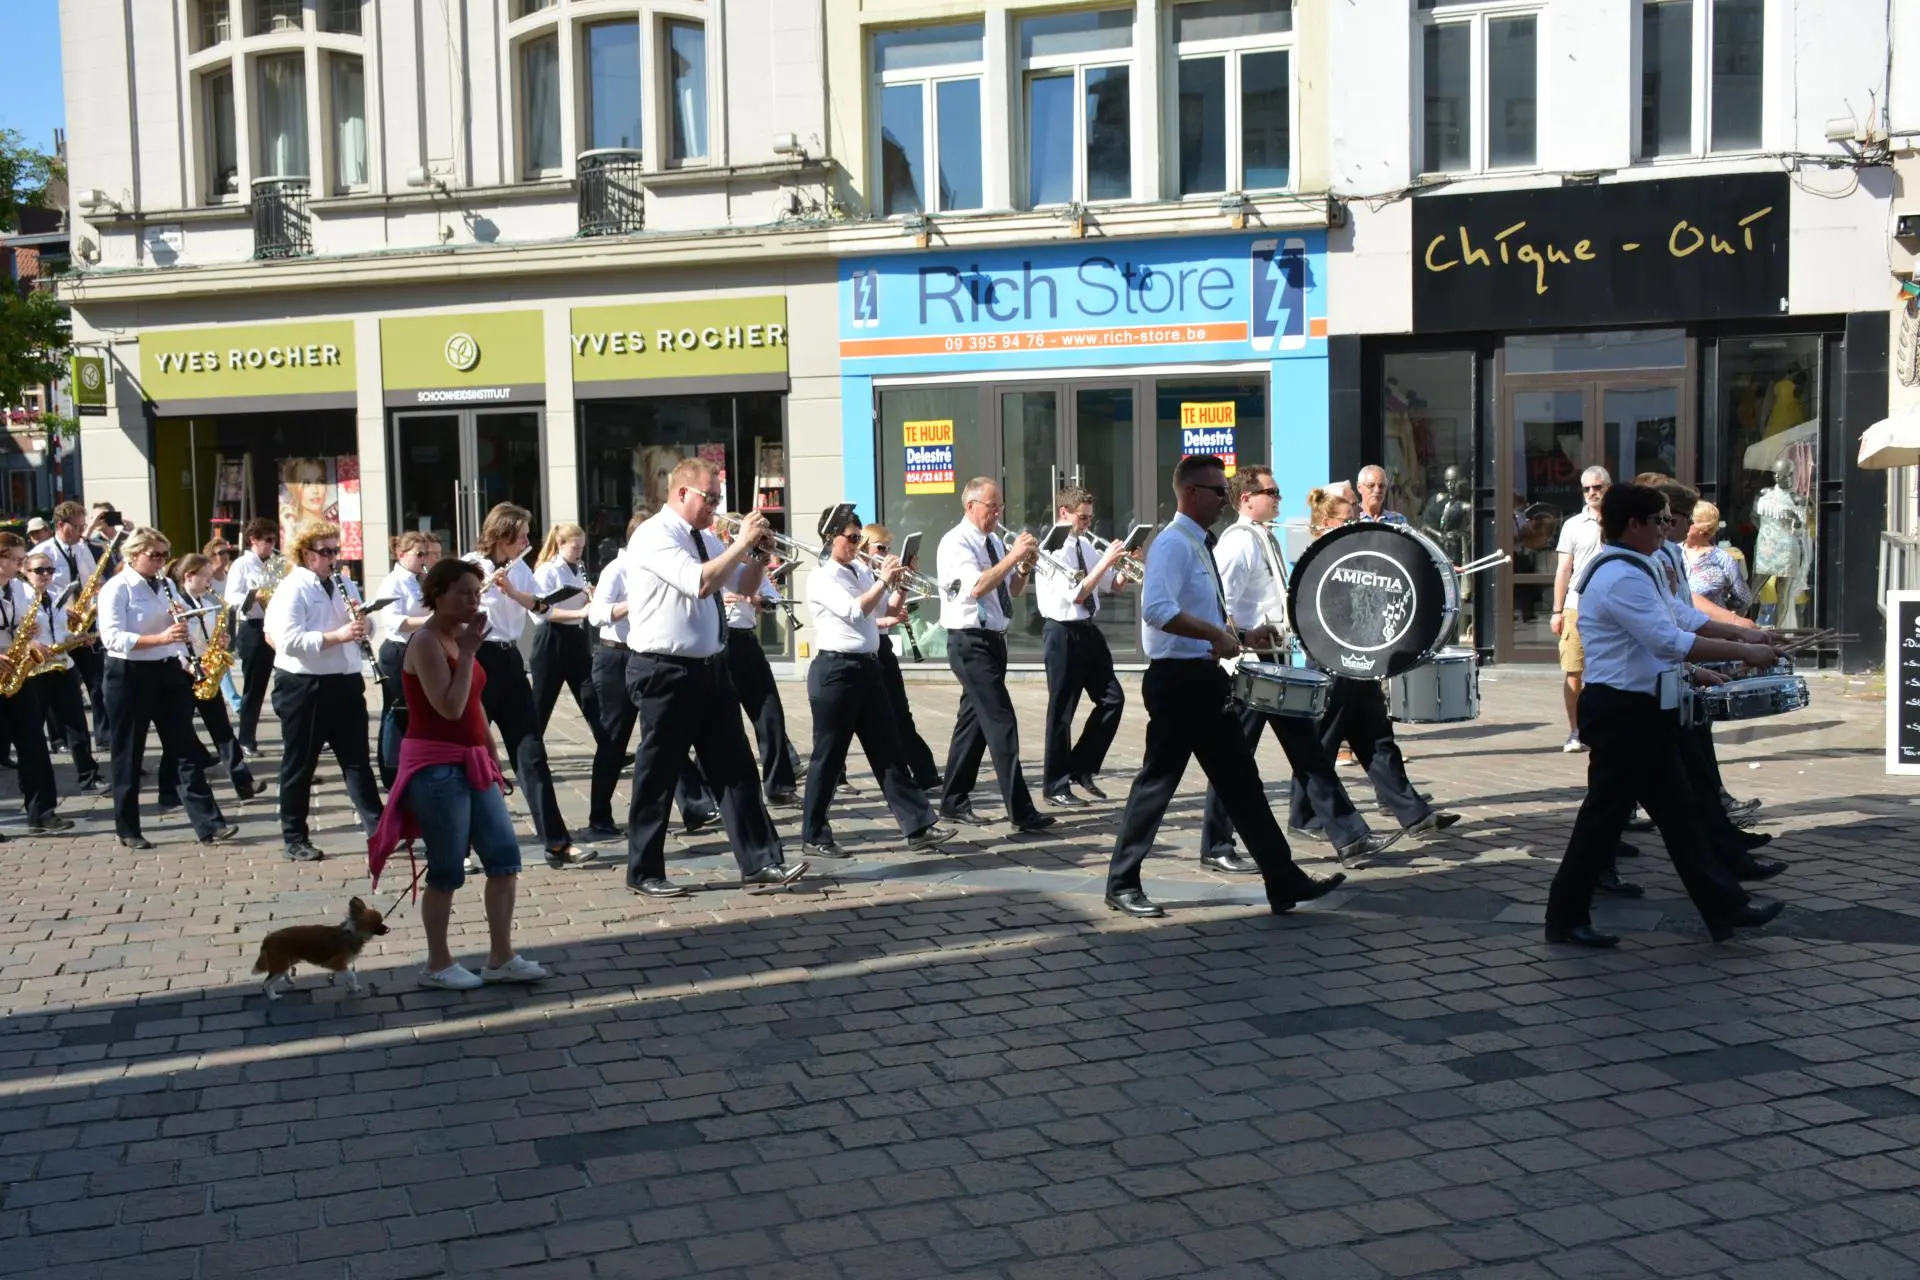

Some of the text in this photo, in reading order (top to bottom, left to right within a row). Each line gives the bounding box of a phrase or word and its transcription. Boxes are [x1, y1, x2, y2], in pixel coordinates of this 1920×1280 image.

[1424, 220, 1596, 295] Chique
[918, 256, 1234, 324] Rich Store
[570, 323, 785, 354] YVES ROCHER
[944, 337, 963, 350] 09
[969, 336, 996, 349] 395
[1002, 335, 1020, 348] 94
[1026, 334, 1045, 348] 76
[1062, 327, 1206, 345] www.rich-store.be
[155, 344, 339, 372] YVES ROCHER
[417, 388, 511, 402] SCHOONHEIDSINSTITUUT
[1184, 406, 1233, 424] TE HUUR
[906, 424, 951, 442] TE HUUR
[1184, 428, 1234, 447] Delestré
[906, 445, 952, 464] Delestré
[1331, 569, 1403, 590] AMICITIA
